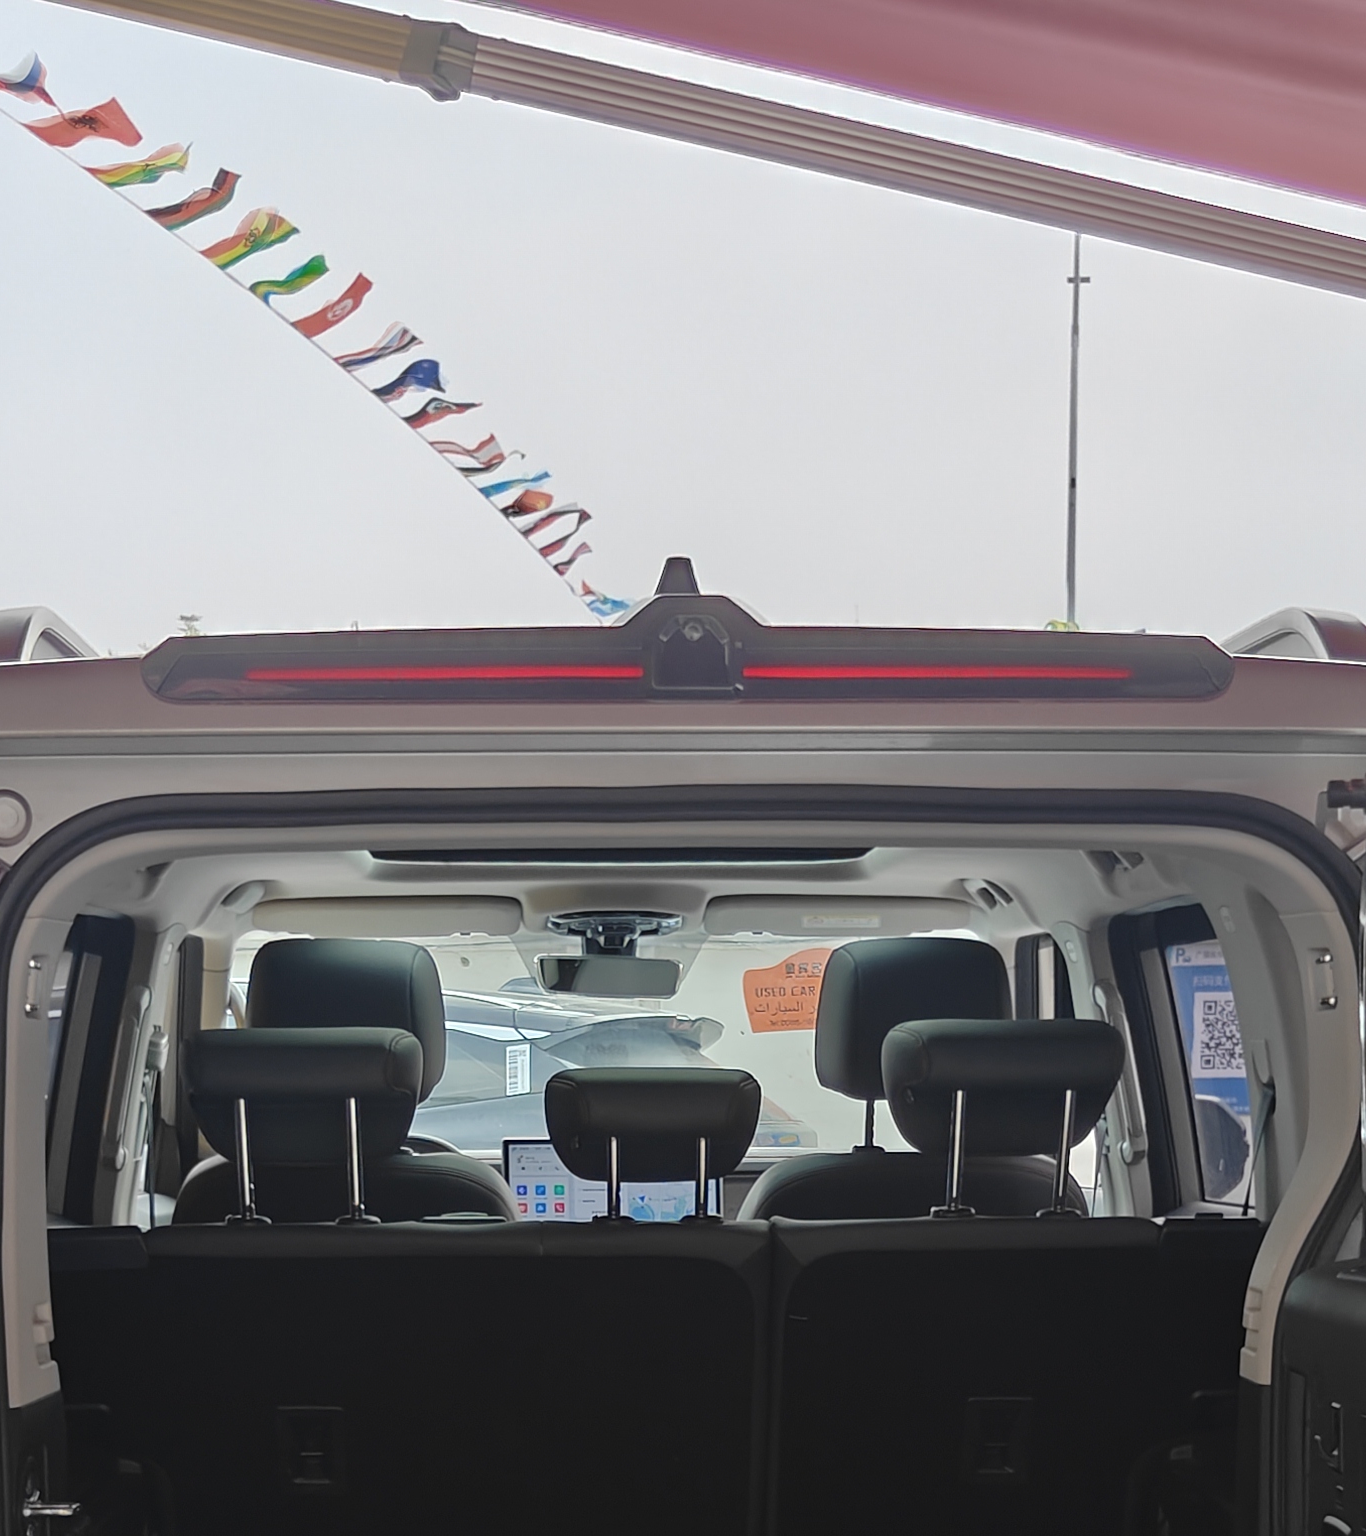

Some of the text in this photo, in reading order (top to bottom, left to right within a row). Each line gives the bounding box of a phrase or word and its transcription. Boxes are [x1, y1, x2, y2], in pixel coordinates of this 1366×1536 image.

[754, 985, 816, 999] USED CAR
[754, 1000, 804, 1017] السيارات
